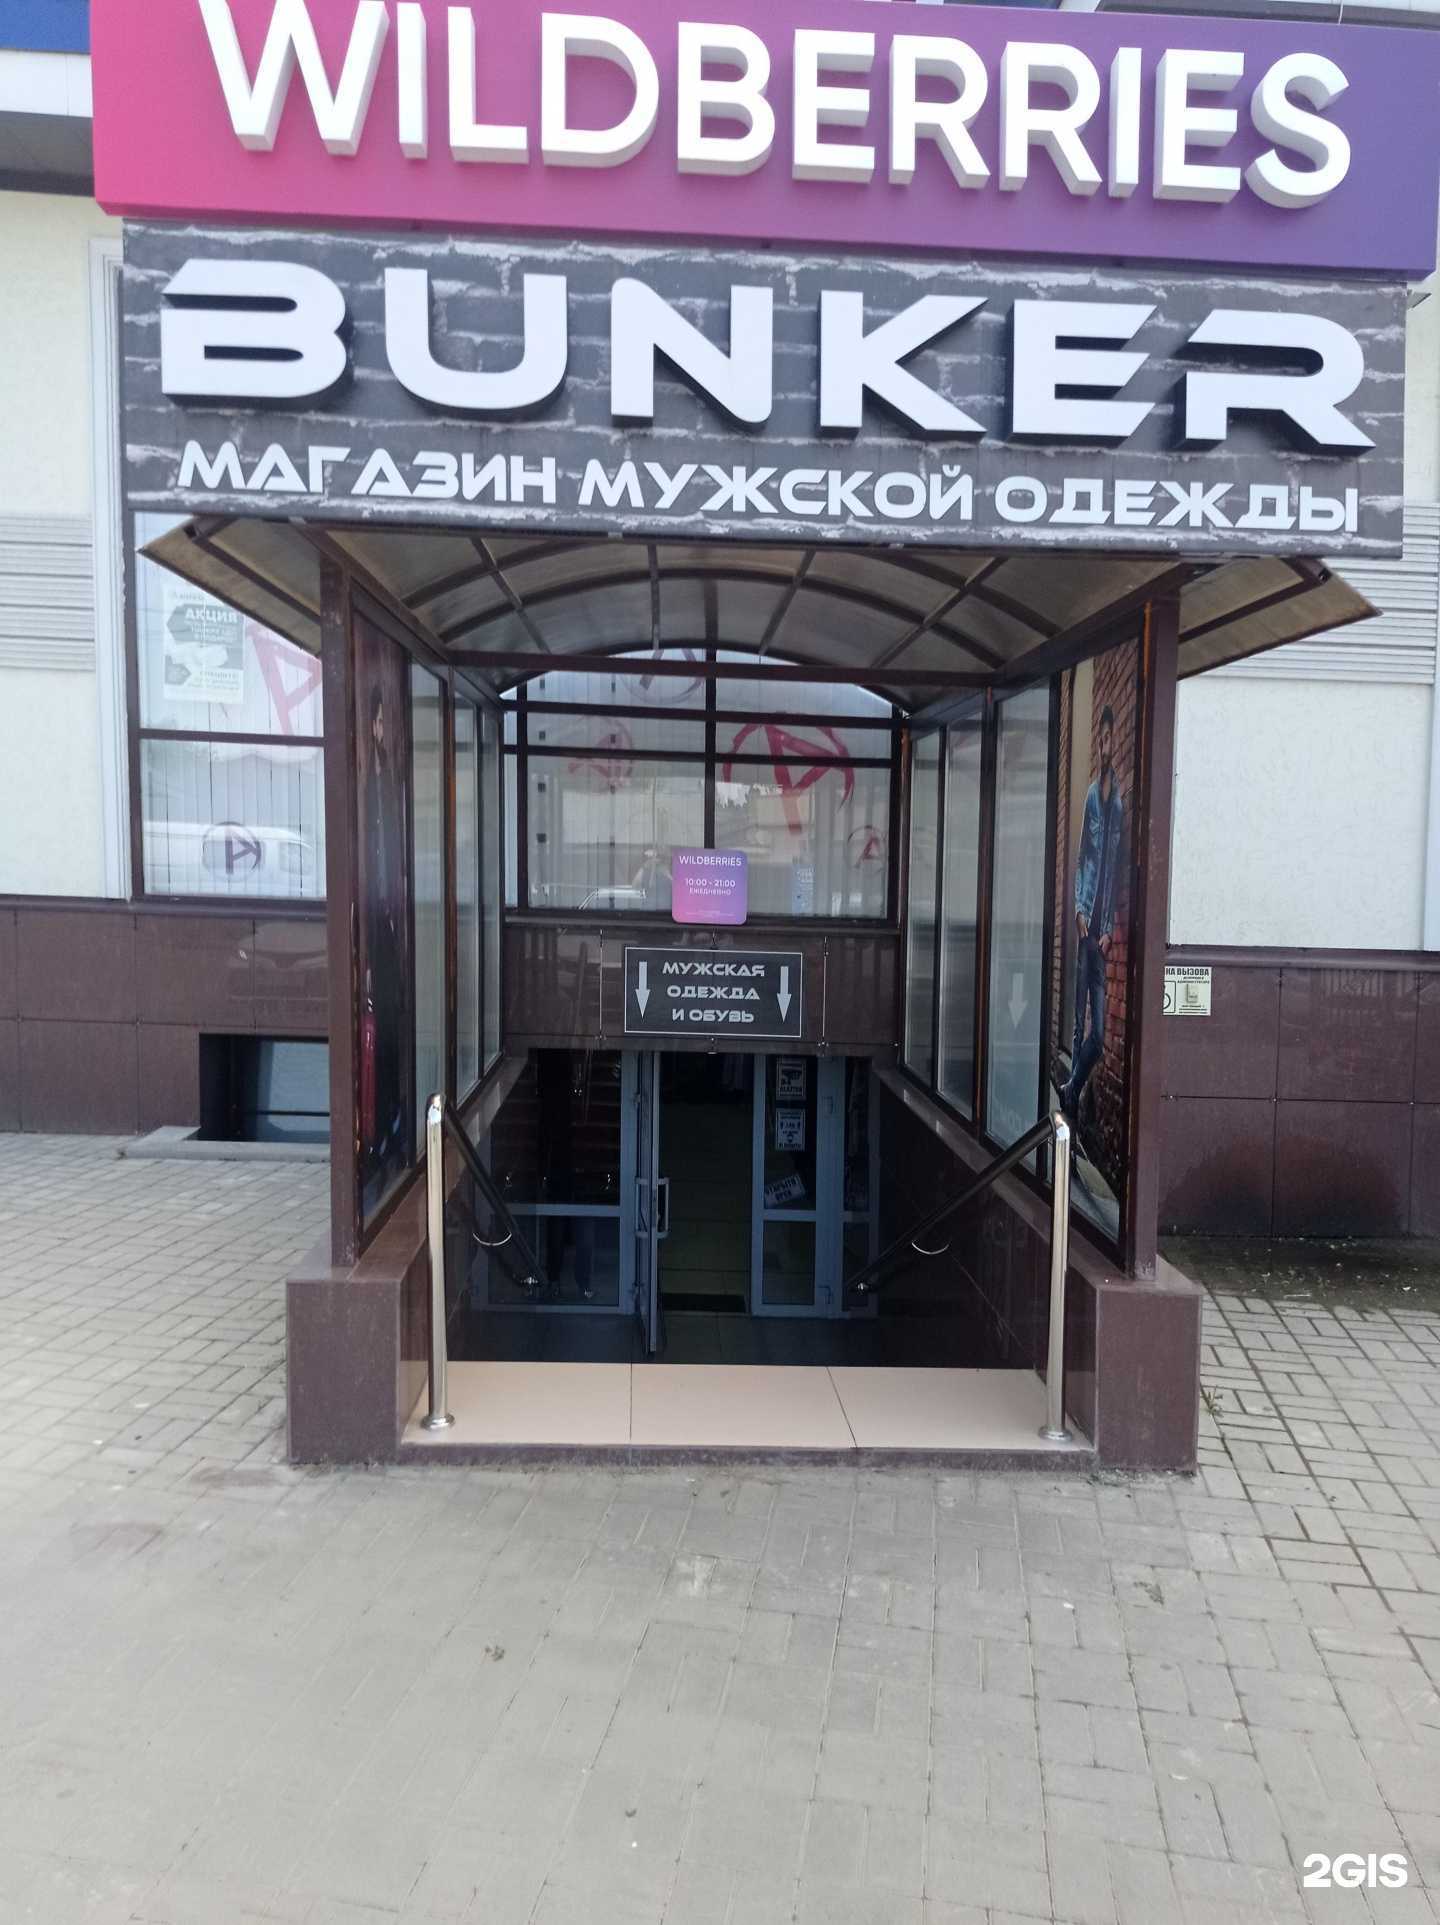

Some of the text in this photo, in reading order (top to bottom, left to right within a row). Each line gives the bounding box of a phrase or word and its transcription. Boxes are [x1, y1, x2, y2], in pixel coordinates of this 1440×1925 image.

[200, 0, 1351, 209] WILDBERRIES
[160, 258, 1376, 454] BUNKER
[177, 439, 1358, 533] МАГАЗИН МУЖСКОЙ ОДЕЖДЫ
[185, 607, 238, 624] АКЦИЯ
[679, 855, 742, 866] WILDBERRIES
[685, 878, 707, 888] 10:00
[714, 878, 736, 888] 21:00
[662, 961, 765, 977] МУЖСКАЯ
[666, 985, 761, 1000] ОДЕЖДА
[672, 1008, 755, 1023] И ОБУВЬ
